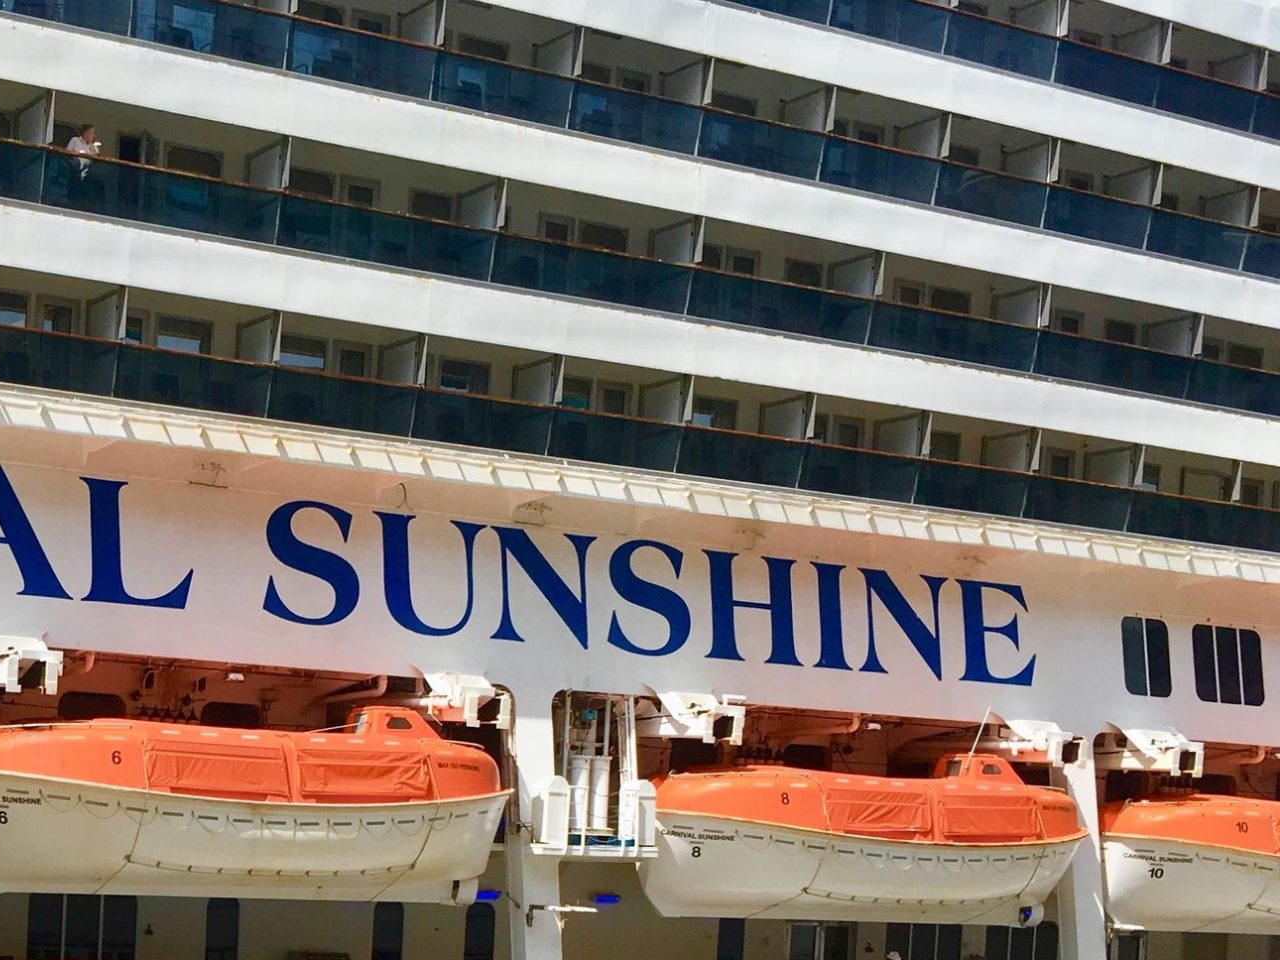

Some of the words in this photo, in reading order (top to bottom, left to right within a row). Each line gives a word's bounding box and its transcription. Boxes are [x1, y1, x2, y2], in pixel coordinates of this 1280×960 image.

[261, 499, 1037, 687] SUNSHINE
[111, 750, 122, 765] 6
[1, 795, 42, 805] SUNSHINE
[780, 791, 790, 805] 8
[1235, 821, 1249, 833] 10
[661, 829, 696, 840] CARNIVAL
[697, 833, 736, 842] SUNSHINE
[691, 846, 702, 858] 8
[1123, 852, 1157, 862] CARNIVAL
[1158, 856, 1194, 864] SUNSHINE
[1148, 867, 1164, 879] 10
